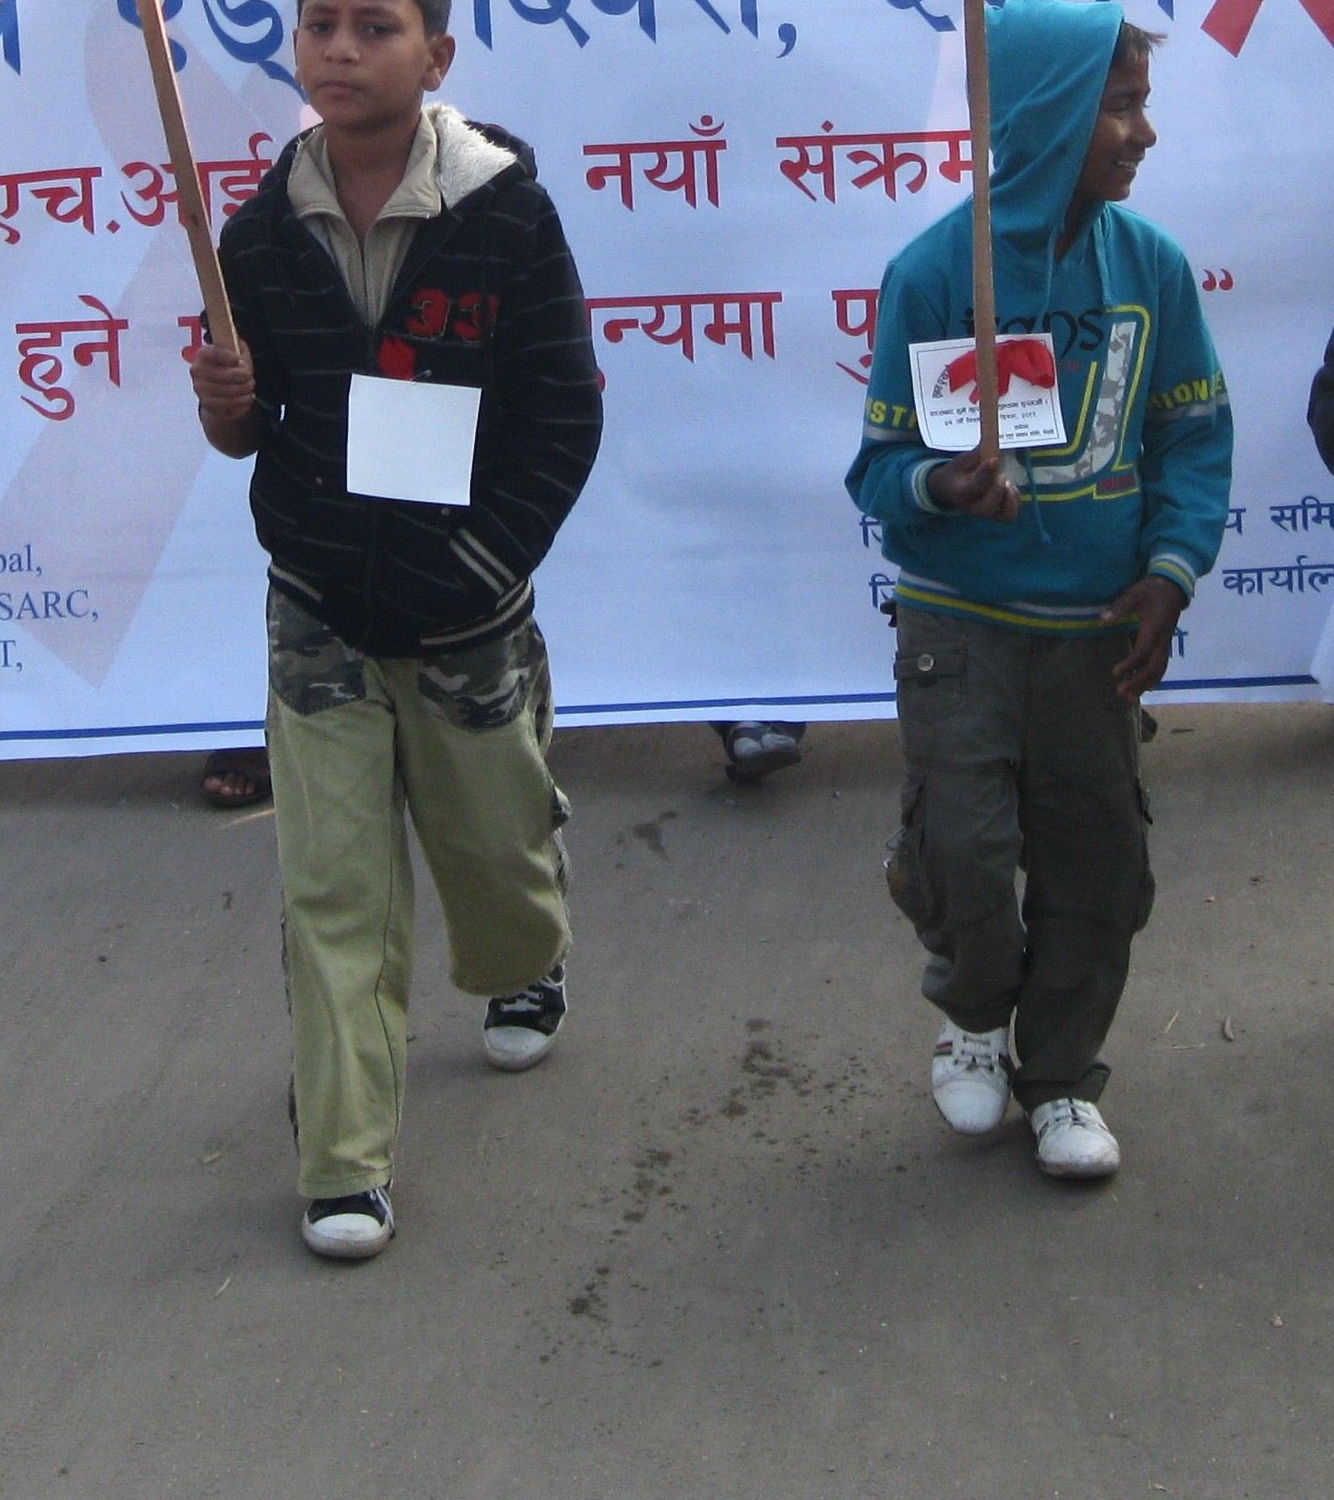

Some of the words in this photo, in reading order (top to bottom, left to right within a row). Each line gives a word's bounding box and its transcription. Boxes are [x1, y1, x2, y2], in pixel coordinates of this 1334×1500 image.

[583, 115, 728, 212] नयाँ
[776, 120, 975, 203] संक्रम
[15, 295, 128, 422] हुने
